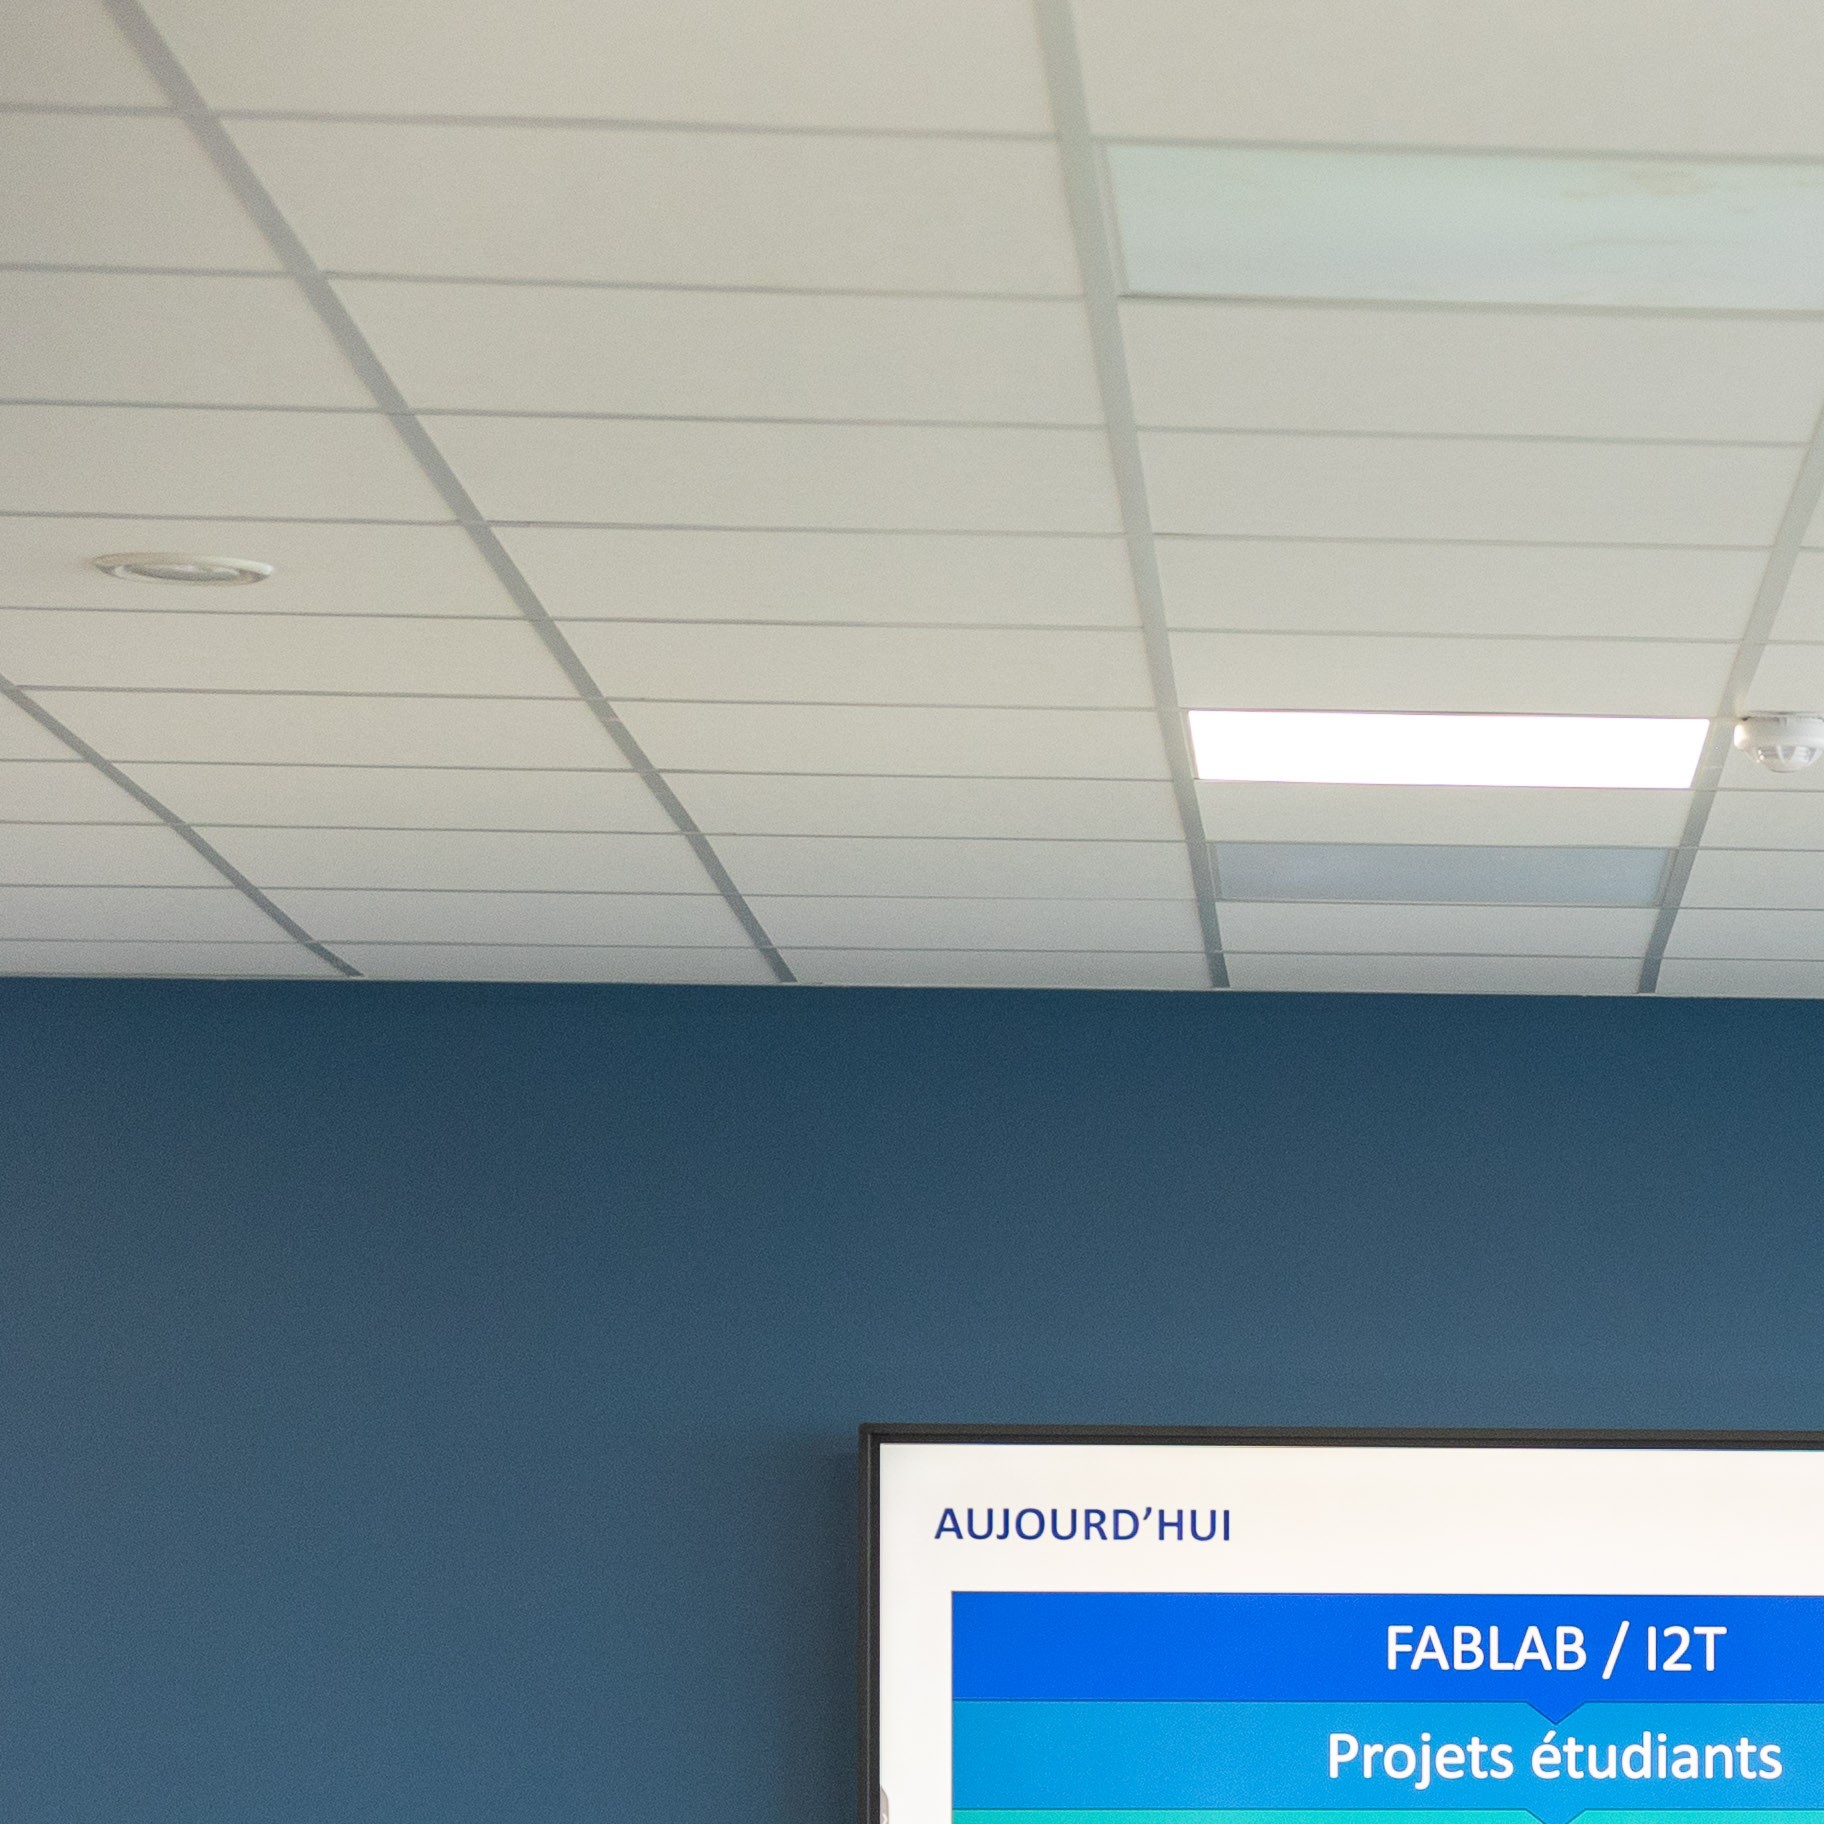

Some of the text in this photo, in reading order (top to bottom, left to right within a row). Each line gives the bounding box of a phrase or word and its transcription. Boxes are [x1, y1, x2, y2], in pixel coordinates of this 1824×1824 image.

[934, 1506, 1231, 1542] AUJOURD’HUI
[1387, 1620, 1728, 1680] FABLAB / I2T
[1329, 1730, 1783, 1790] Projets étudiants
